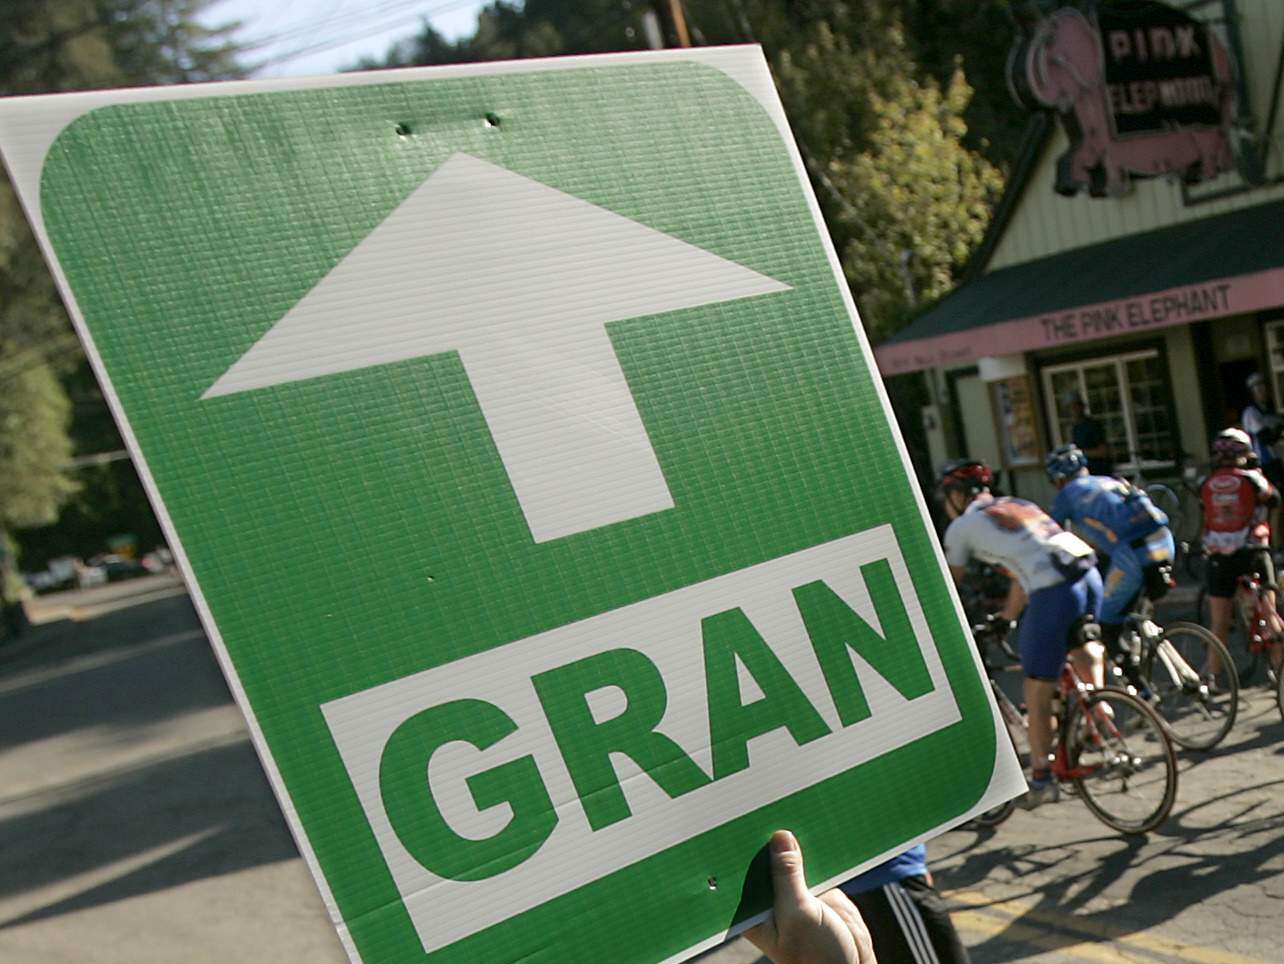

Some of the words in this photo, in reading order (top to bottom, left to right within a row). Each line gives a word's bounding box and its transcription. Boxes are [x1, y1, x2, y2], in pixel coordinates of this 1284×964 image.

[1108, 26, 1201, 62] PINK
[1039, 314, 1077, 341] THE
[1080, 304, 1124, 335] PINK
[1127, 284, 1231, 327] ELEPHANT
[378, 558, 935, 882] GRAN
